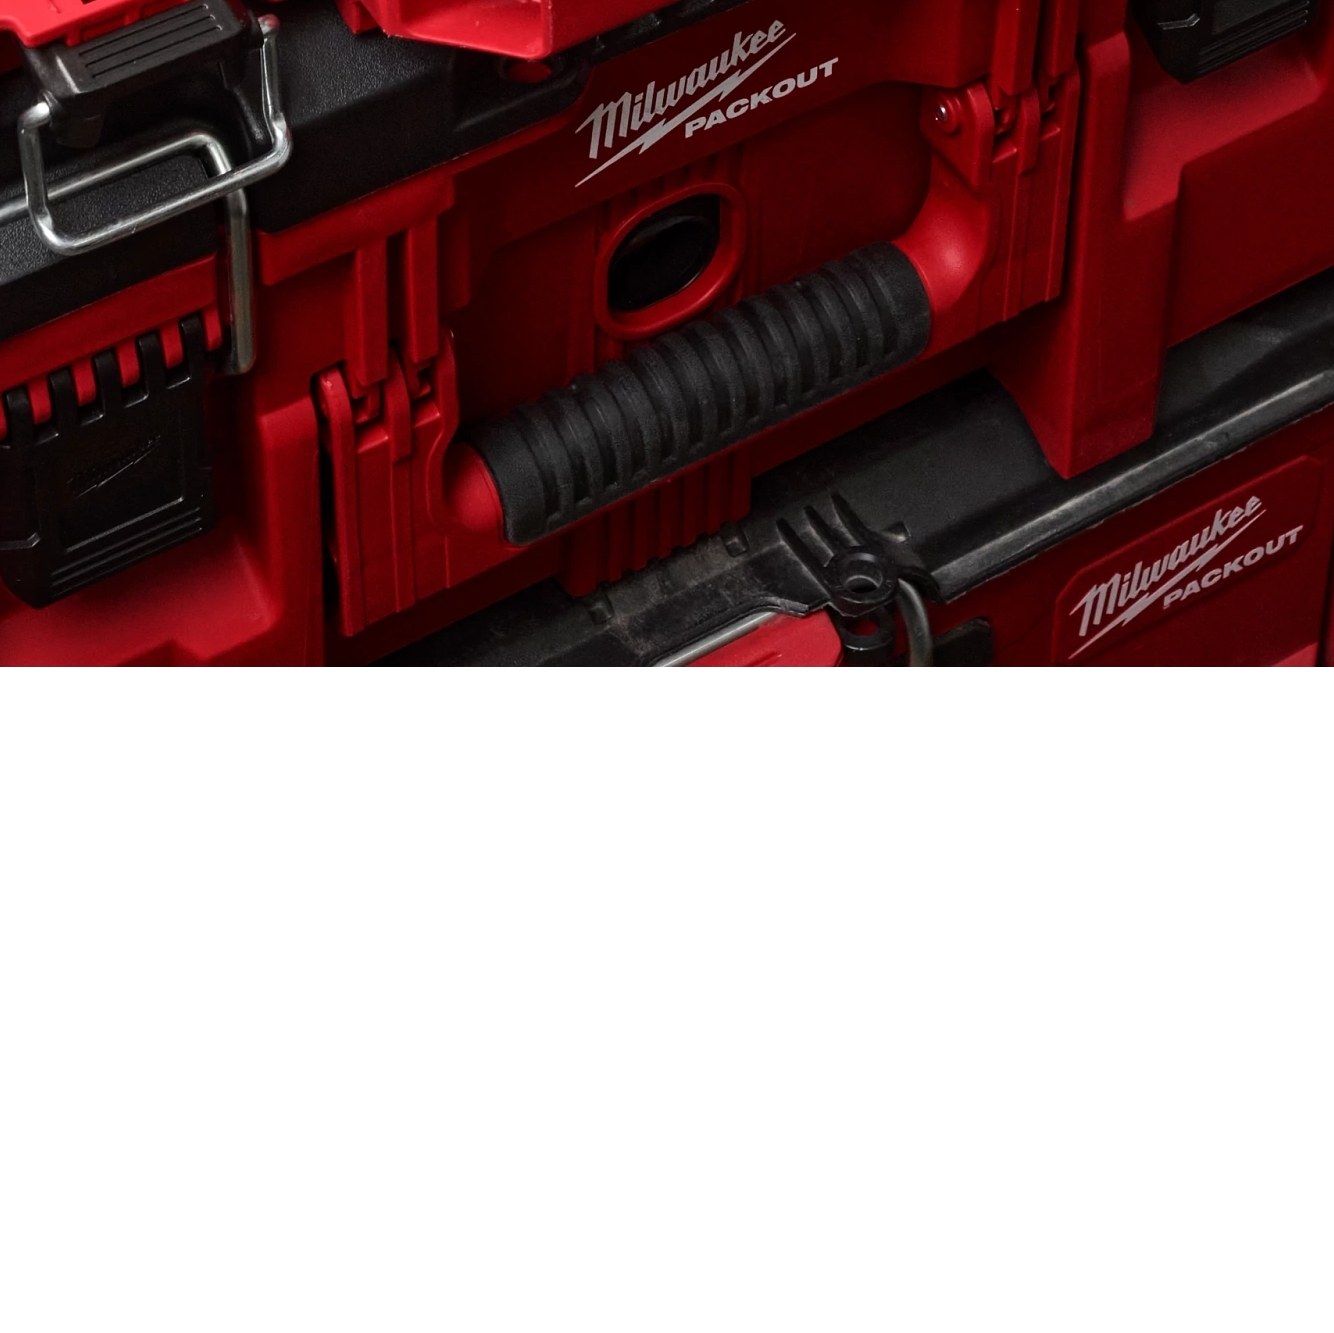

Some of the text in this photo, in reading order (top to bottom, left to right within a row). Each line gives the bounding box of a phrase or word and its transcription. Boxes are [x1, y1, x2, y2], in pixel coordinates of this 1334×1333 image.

[575, 20, 786, 159] Milwaukee
[685, 57, 839, 139] PACKOUT
[1069, 496, 1262, 637] Milwaukee
[1163, 525, 1303, 611] PACKOUT
